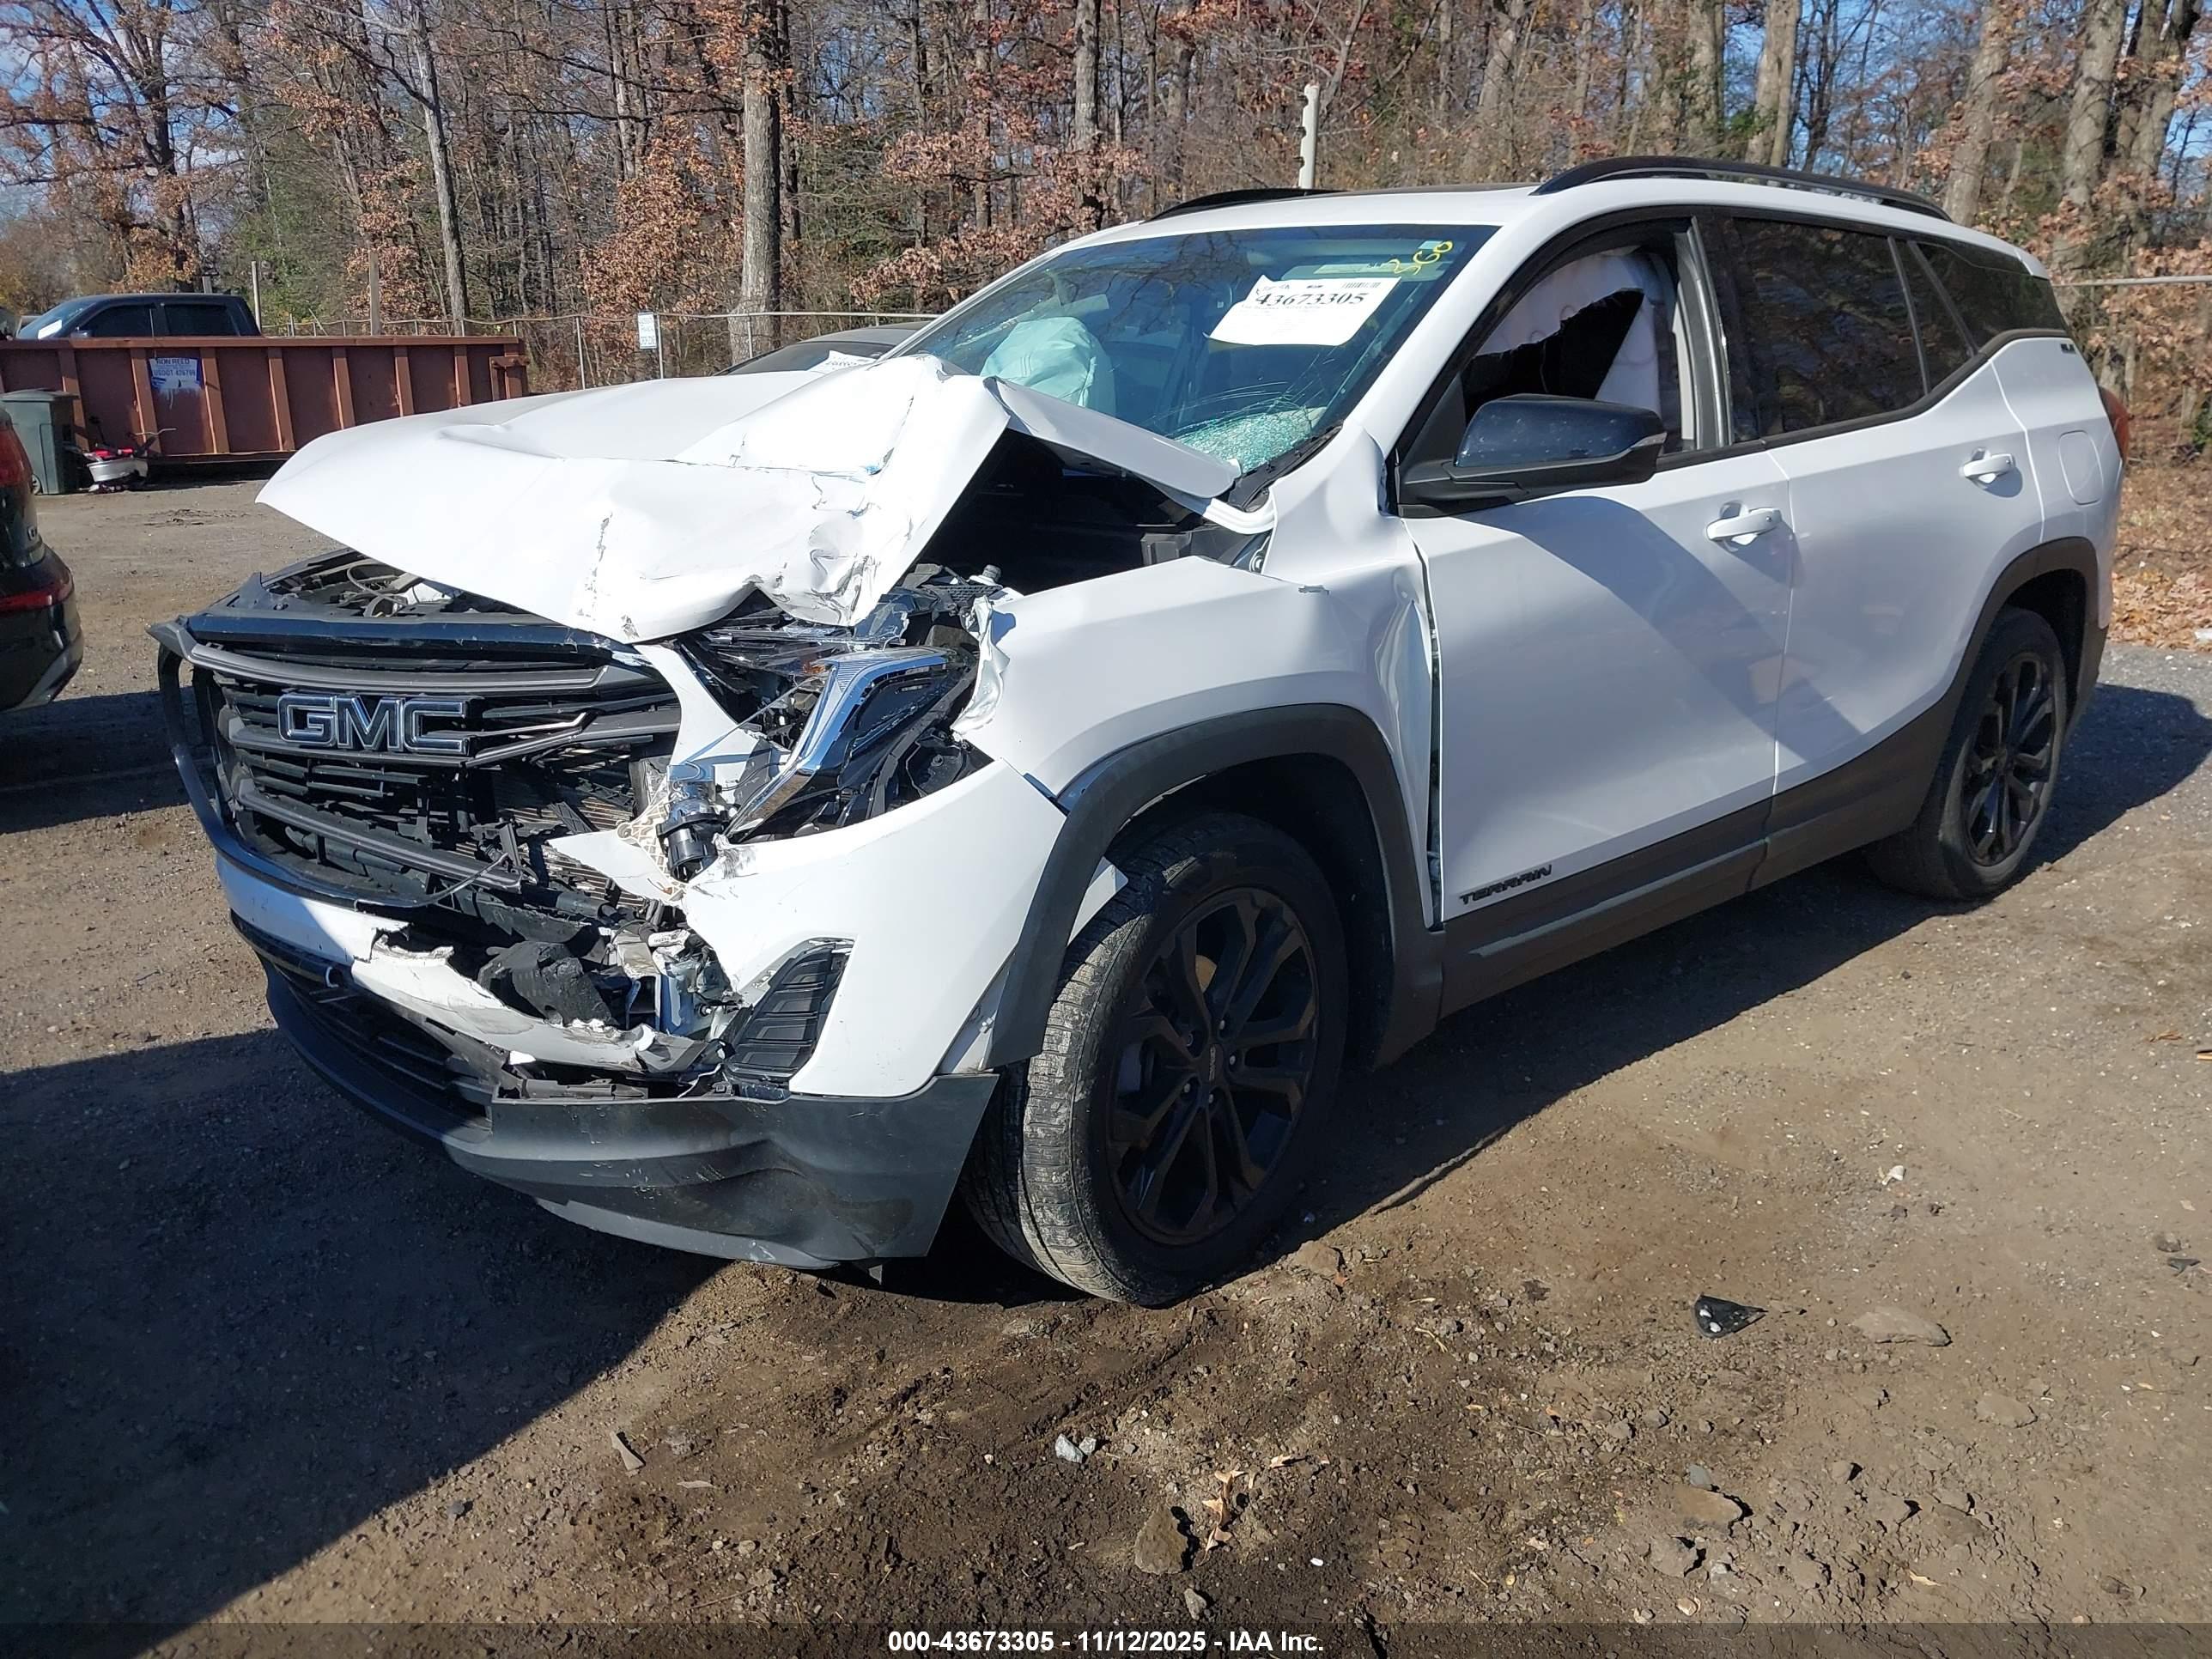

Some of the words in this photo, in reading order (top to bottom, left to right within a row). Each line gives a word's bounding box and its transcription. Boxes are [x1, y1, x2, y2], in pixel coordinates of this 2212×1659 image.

[1255, 292, 1370, 307] 43673305
[277, 691, 471, 756] GMC
[1459, 864, 1553, 905] TERRAIN
